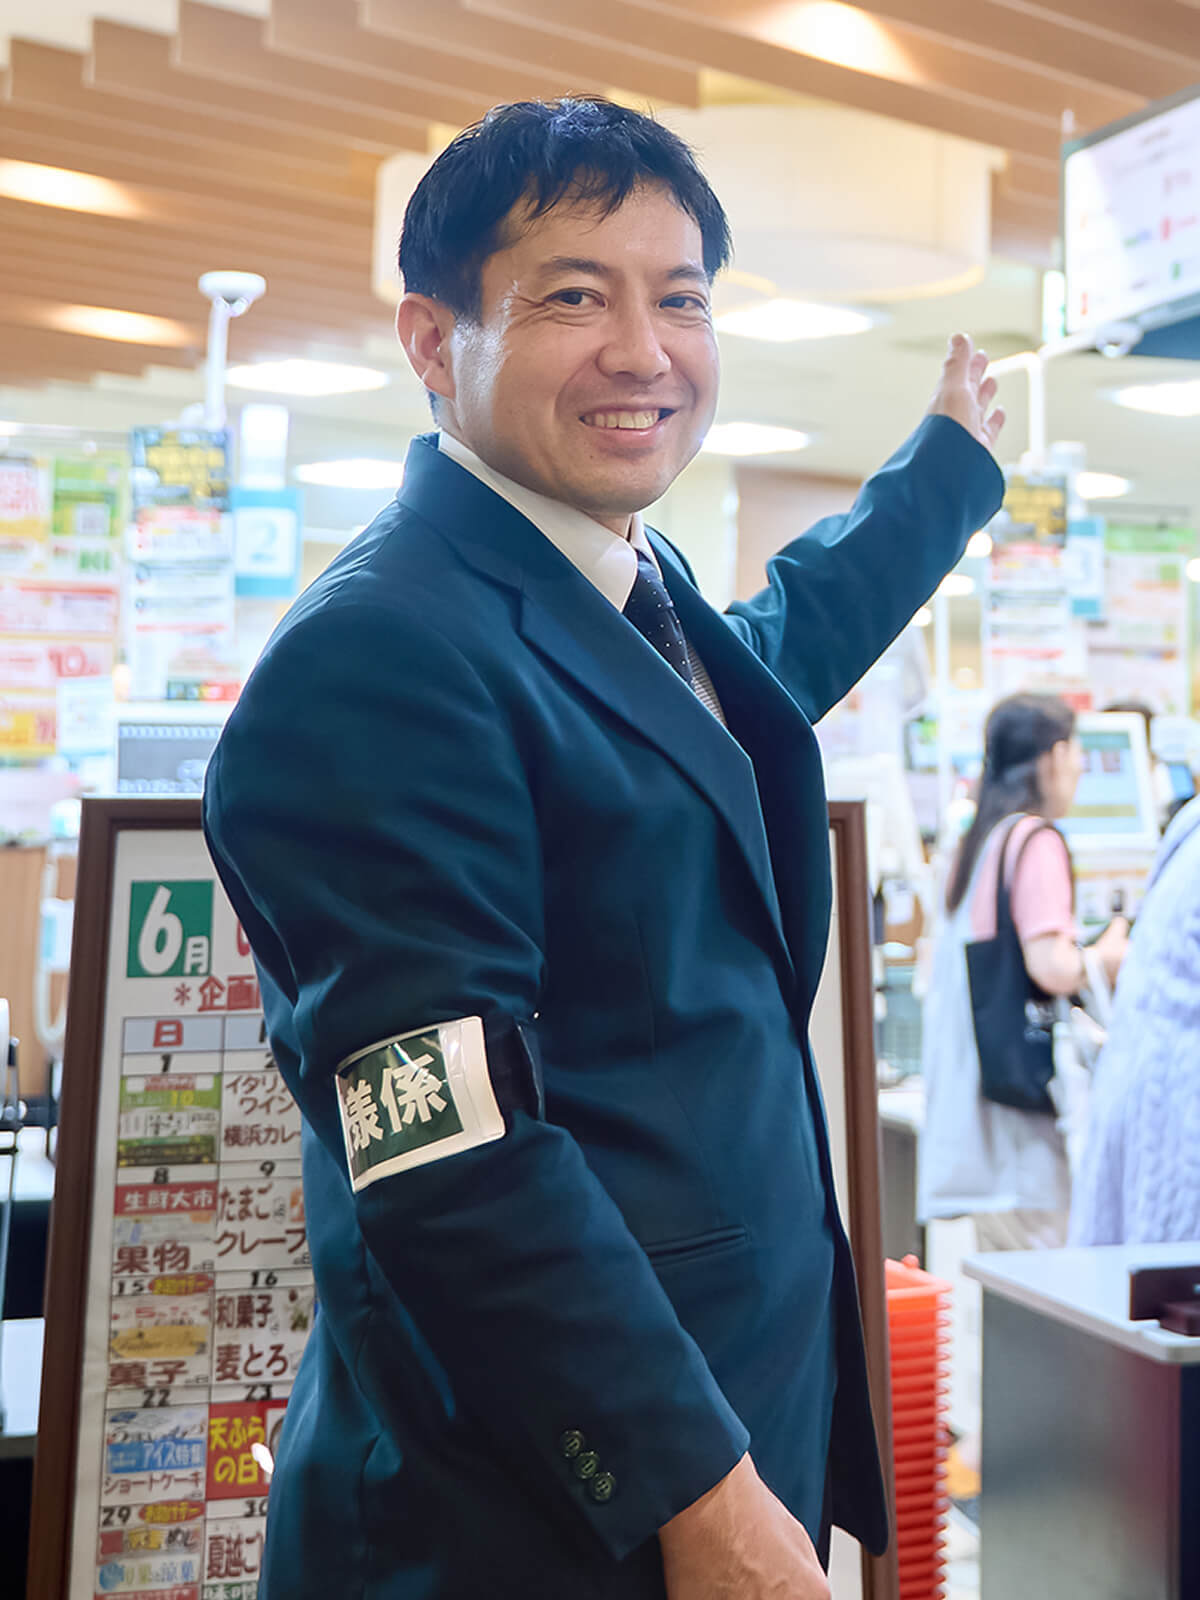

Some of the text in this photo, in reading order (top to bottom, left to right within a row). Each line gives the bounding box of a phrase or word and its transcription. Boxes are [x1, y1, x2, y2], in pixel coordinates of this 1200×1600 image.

[138, 884, 210, 976] 6月
[153, 1019, 184, 1048] 日
[160, 1053, 172, 1073] 1
[226, 1074, 288, 1095] イタリ
[239, 1096, 296, 1116] ワイン
[153, 1167, 170, 1184] 8
[260, 1161, 275, 1177] 9
[124, 1189, 213, 1212] 生鮮大市
[218, 1182, 273, 1223] たまご
[117, 1279, 145, 1295] 15
[251, 1271, 278, 1287] 16
[216, 1294, 273, 1329] 和菓子
[216, 1343, 288, 1382] 麦とろ
[142, 1389, 171, 1408] 22
[245, 1384, 273, 1402] 23
[213, 1453, 259, 1485] の日
[102, 1506, 131, 1526] 29
